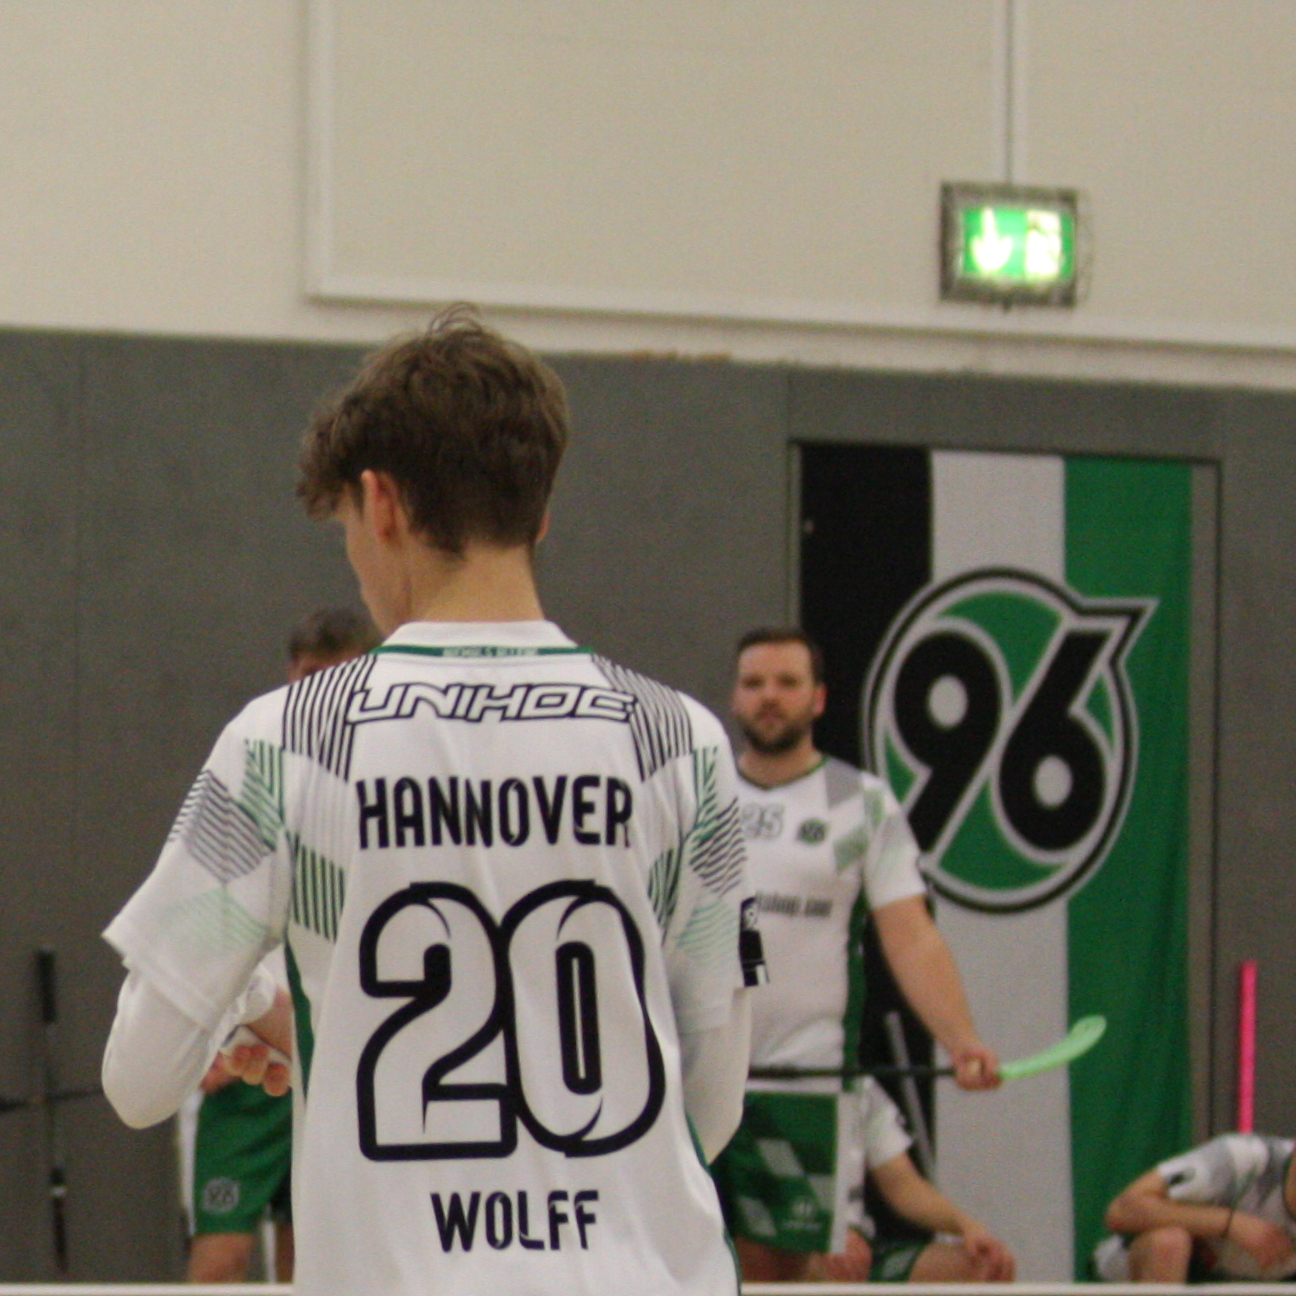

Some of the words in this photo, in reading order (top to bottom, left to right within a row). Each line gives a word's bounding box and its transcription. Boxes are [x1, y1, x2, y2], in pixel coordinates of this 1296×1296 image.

[345, 682, 640, 725] UNIHOC
[892, 628, 1110, 853] 96
[355, 774, 633, 850] HANNOVER
[356, 879, 666, 1162] 20
[430, 1189, 600, 1253] WOLFF
